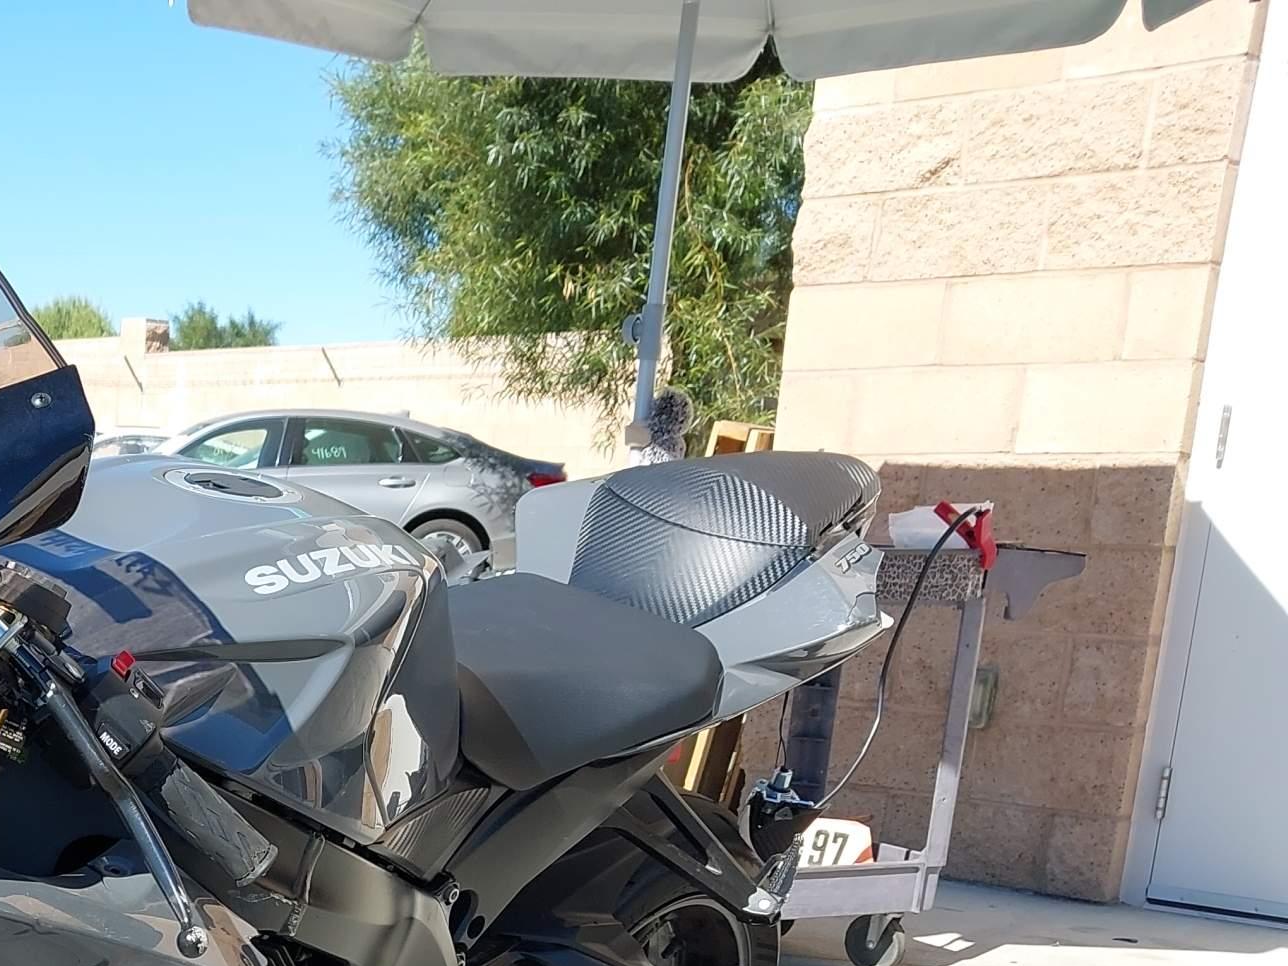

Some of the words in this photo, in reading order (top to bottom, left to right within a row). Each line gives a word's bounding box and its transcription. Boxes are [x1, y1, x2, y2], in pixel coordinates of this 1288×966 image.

[244, 544, 420, 595] SUZUKI
[834, 543, 872, 574] 750
[99, 731, 123, 756] MODE
